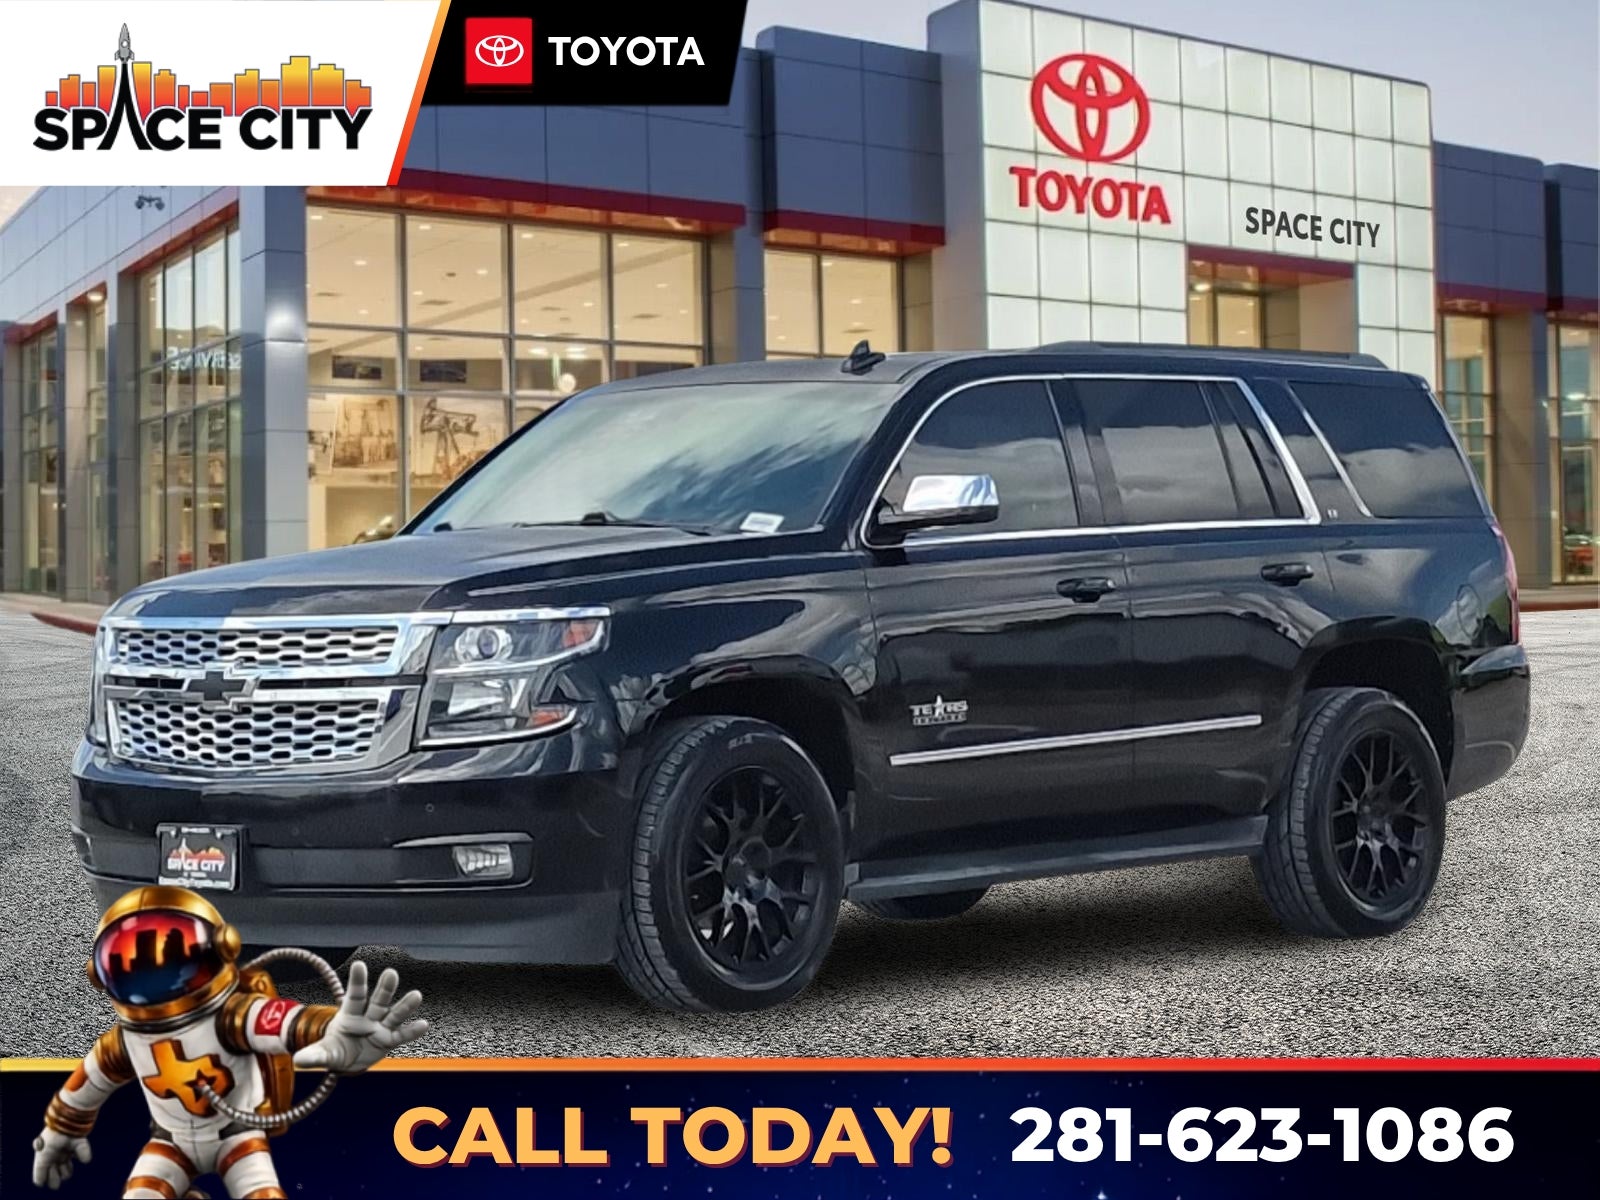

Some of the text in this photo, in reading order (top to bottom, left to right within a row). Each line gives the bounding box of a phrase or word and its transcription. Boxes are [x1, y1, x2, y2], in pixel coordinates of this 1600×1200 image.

[1009, 165, 1171, 224] TOYOTA
[1245, 206, 1381, 248] SPACE CITY
[200, 859, 226, 872] CITY
